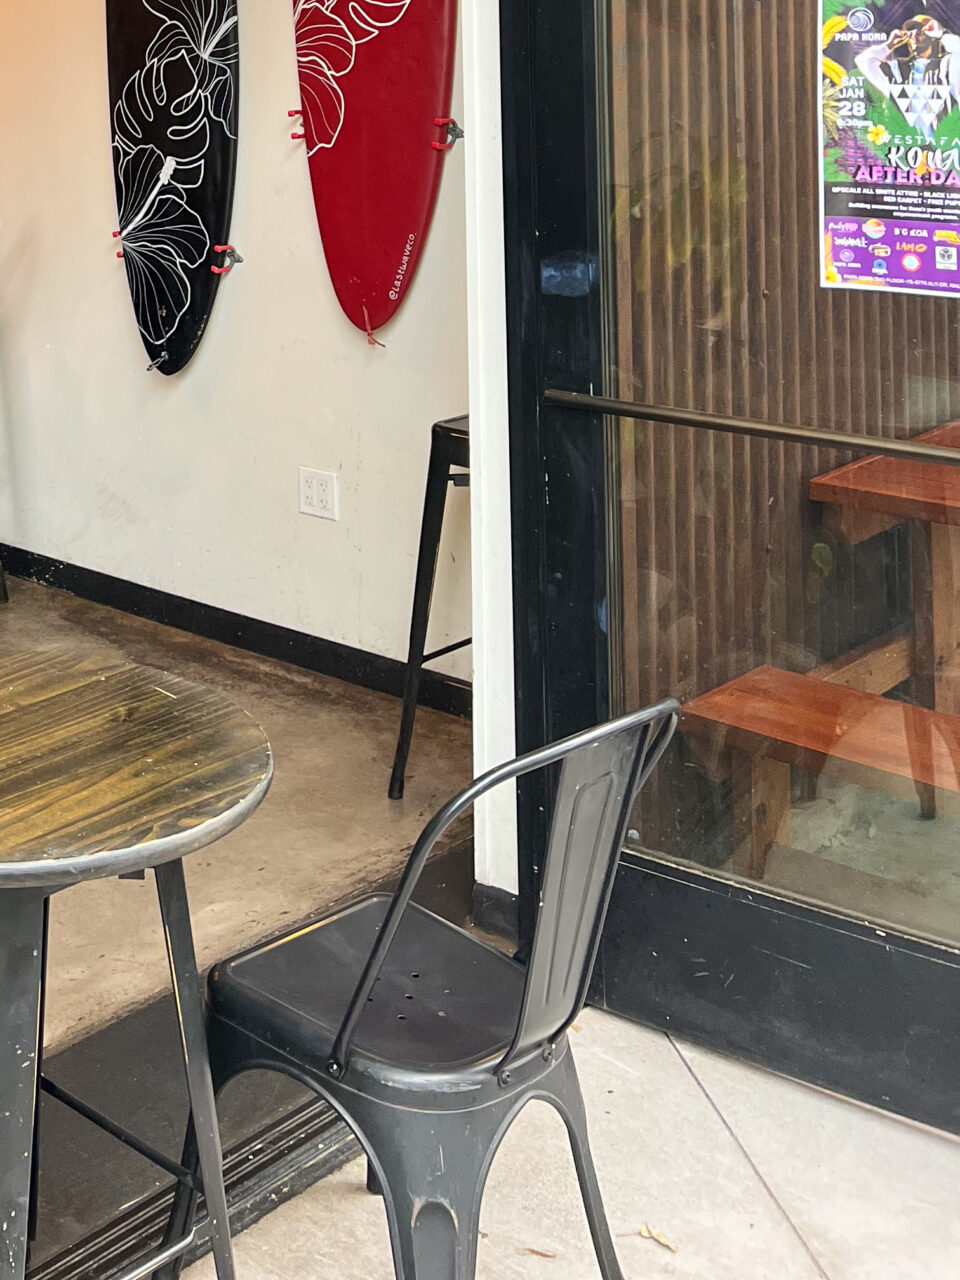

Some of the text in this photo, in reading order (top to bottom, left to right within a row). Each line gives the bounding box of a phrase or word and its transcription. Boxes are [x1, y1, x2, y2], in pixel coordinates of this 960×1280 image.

[841, 76, 865, 87] SAT
[838, 87, 865, 98] JAN
[838, 100, 866, 116] 28
[855, 165, 923, 185] AFTER
